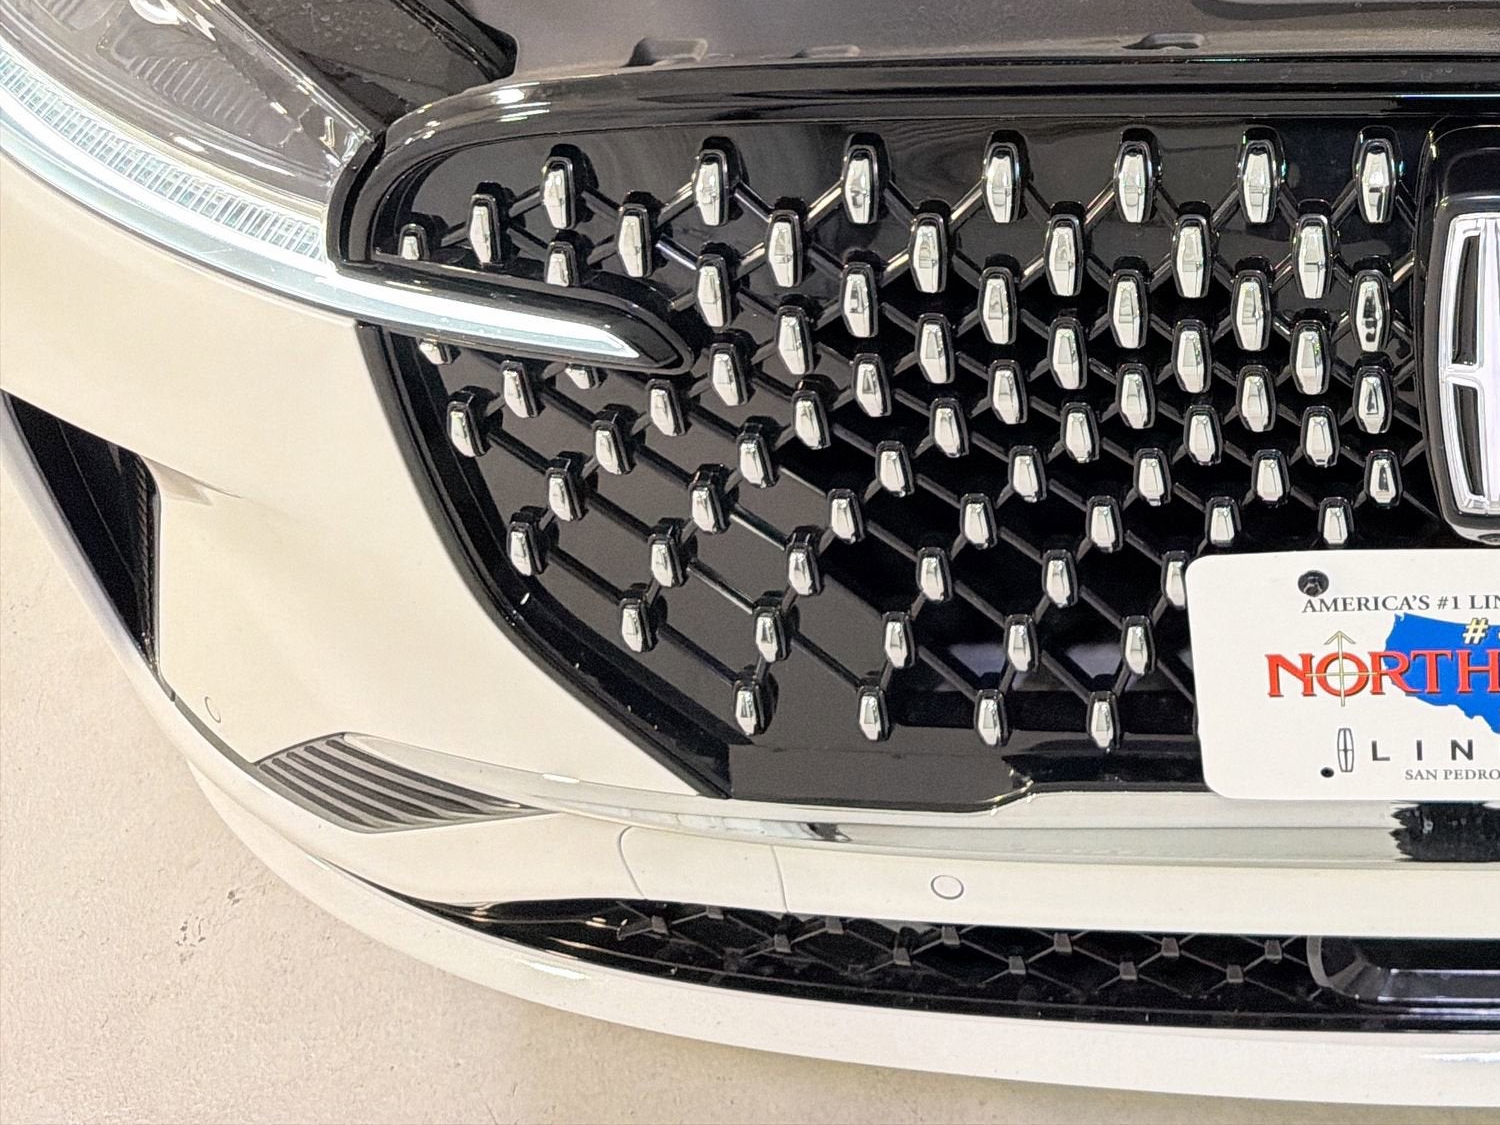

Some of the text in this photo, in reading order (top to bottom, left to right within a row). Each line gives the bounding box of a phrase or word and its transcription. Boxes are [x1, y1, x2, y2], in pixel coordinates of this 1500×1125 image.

[1301, 594, 1430, 614] AMERICA'S
[1436, 594, 1461, 611] #1
[1405, 768, 1439, 781] SAN
[1443, 768, 1500, 781] PEDRO
